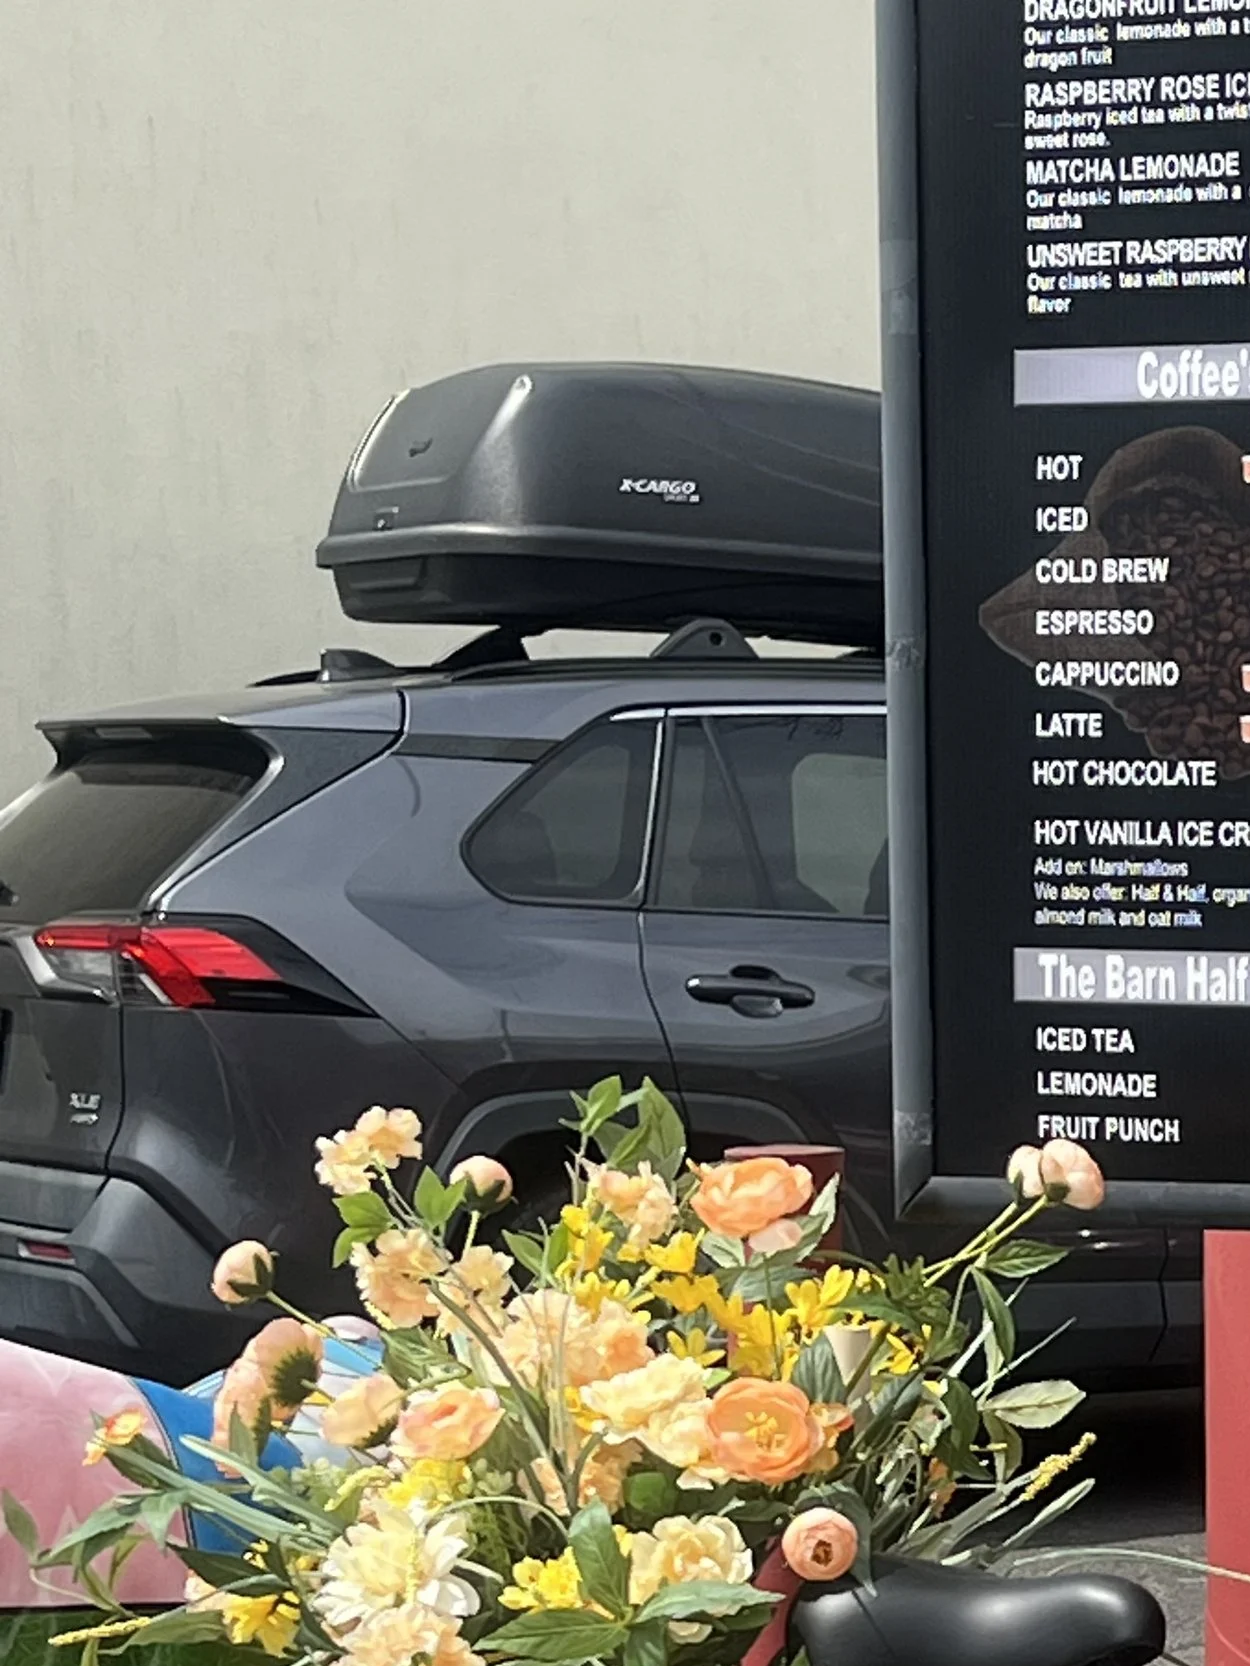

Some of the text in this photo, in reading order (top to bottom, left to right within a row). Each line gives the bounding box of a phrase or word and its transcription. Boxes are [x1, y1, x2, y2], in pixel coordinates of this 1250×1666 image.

[1025, 0, 1178, 22] DRAGONFRUIT
[1023, 26, 1052, 45] Our
[1055, 23, 1108, 44] classic
[1116, 19, 1190, 40] lemonade
[1194, 17, 1226, 36] with
[1230, 19, 1239, 34] a
[1024, 46, 1111, 70] dragon fruit
[1025, 77, 1154, 107] RASPBERRY
[1160, 74, 1219, 100] ROSE
[1024, 108, 1102, 130] Raspberry
[1105, 105, 1137, 125] iced
[1140, 106, 1164, 123] tea
[1167, 103, 1200, 121] with
[1203, 105, 1213, 120] a
[1024, 132, 1069, 149] sweet
[1026, 151, 1239, 184] MATCHA LEMONADE
[1026, 189, 1054, 208] Our
[1058, 187, 1110, 206] classic
[1118, 183, 1192, 204] lemonade
[1195, 182, 1227, 201] with
[1231, 184, 1241, 199] a
[1026, 241, 1122, 267] UNSWEET
[1126, 236, 1246, 263] RASPBERRY
[1027, 272, 1055, 291] Our
[1058, 271, 1111, 290] classic
[1119, 271, 1142, 287] tea
[1145, 269, 1178, 286] with
[1181, 267, 1245, 285] unsweet
[1036, 455, 1082, 479] HOT
[1036, 507, 1087, 531] ICED
[1036, 557, 1168, 583] COLD BREW
[1036, 610, 1153, 634] ESPRESSO
[1035, 661, 1178, 686] CAPPUCCINO
[1035, 713, 1102, 737] LATTE
[1032, 760, 1216, 785] HOT CHOCOLATE
[1034, 820, 1079, 844] HOT
[1084, 820, 1172, 845] VANILLA
[1177, 821, 1213, 846] ICE
[1039, 954, 1094, 997] The
[1106, 955, 1174, 999] Barn
[1187, 956, 1247, 1000] Half
[1036, 1027, 1134, 1052] ICED TEA
[1037, 1071, 1155, 1097] LEMONADE
[1038, 1116, 1179, 1141] FRUIT PUNCH
